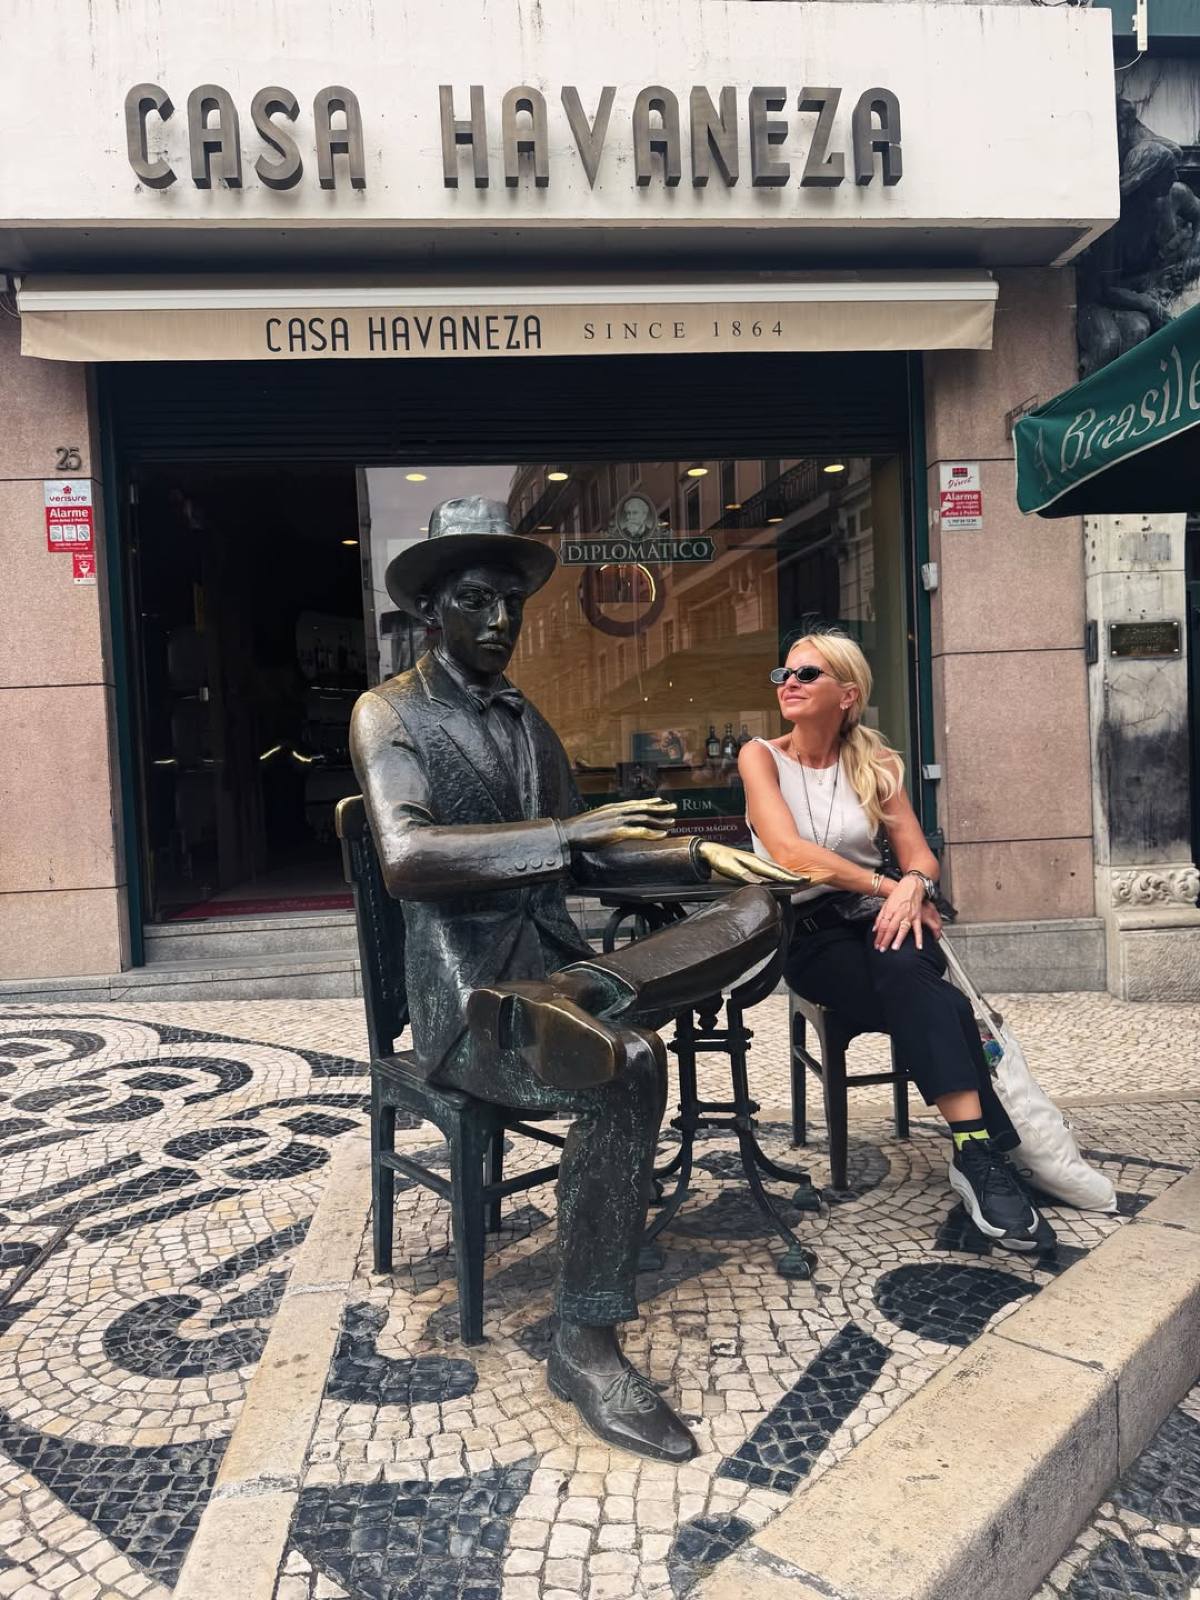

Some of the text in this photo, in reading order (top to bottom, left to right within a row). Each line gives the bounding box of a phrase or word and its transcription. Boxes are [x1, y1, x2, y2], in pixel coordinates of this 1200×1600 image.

[125, 83, 902, 190] CASA HAVANEZA
[266, 315, 784, 352] CASA HAVANEZA SINCE 1864
[56, 447, 82, 471] 25
[945, 493, 979, 501] Alarme
[49, 508, 89, 518] Alarme
